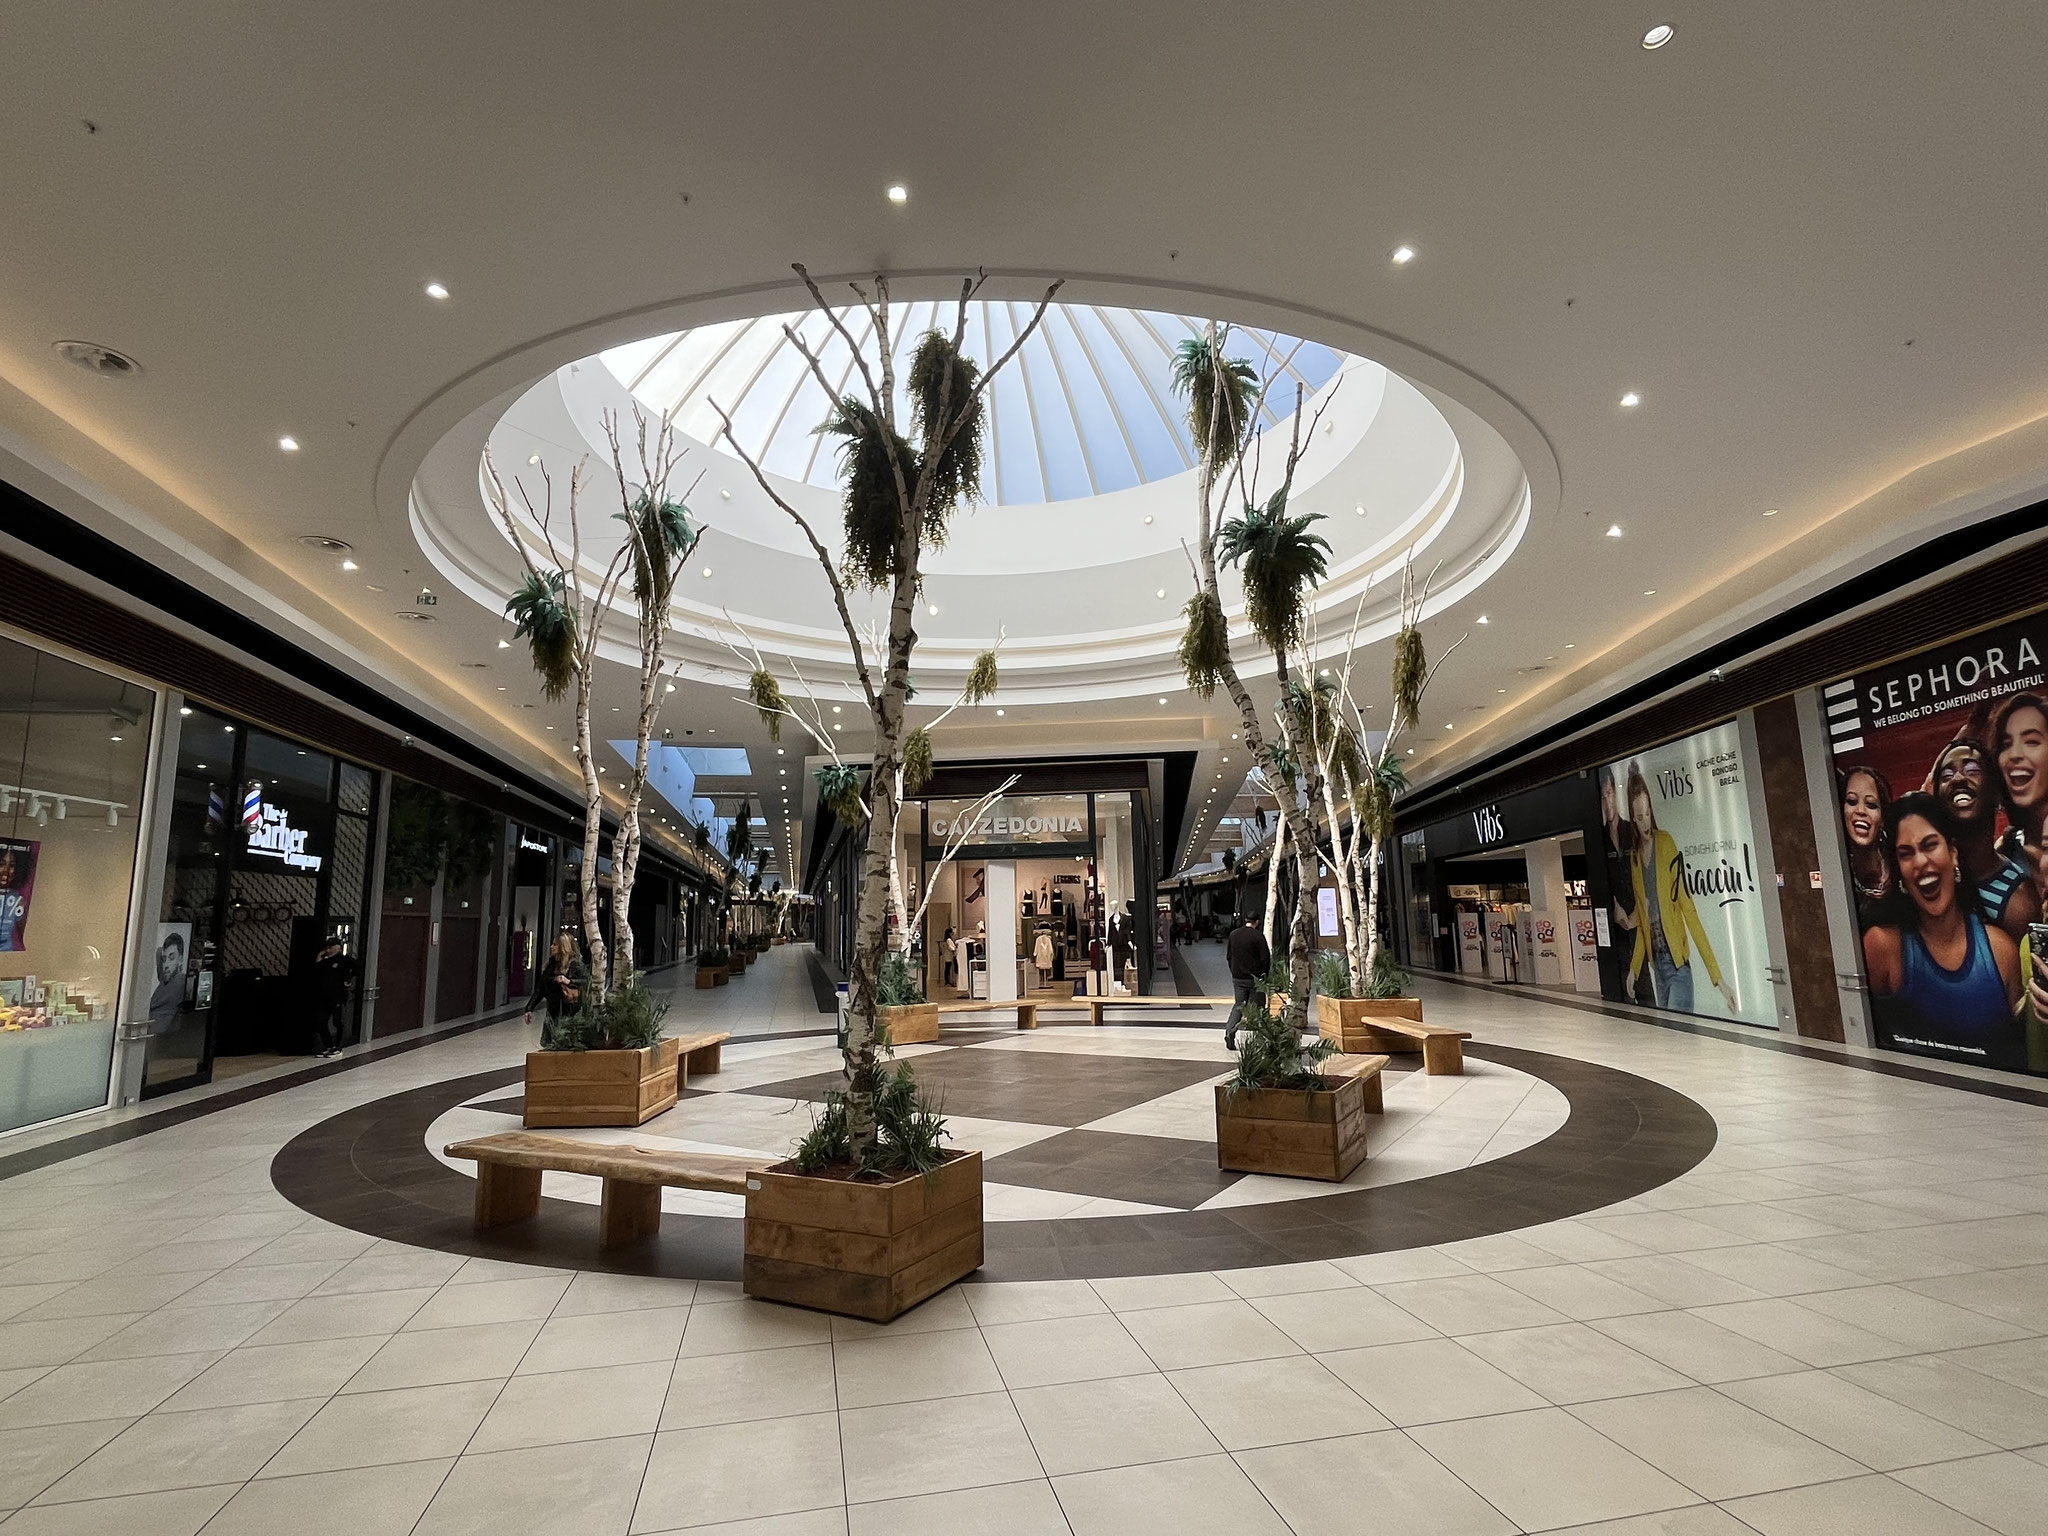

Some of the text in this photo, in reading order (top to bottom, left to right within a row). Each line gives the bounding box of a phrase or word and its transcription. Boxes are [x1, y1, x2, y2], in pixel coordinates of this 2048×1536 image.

[1869, 637, 2041, 714] SEPHORA
[1873, 718, 1887, 729] WE
[1887, 708, 1920, 725] BELONG
[1920, 704, 1933, 716] TO
[1934, 689, 1990, 712] SOMETHING
[1696, 751, 1737, 770] CACHE CACHE
[1711, 763, 1738, 777] BONOBO
[1656, 767, 1694, 800] Vib's
[263, 803, 281, 822] The
[931, 815, 1083, 837] CALZEDONIA
[1472, 805, 1504, 844] Vib's
[248, 813, 308, 853] Barber
